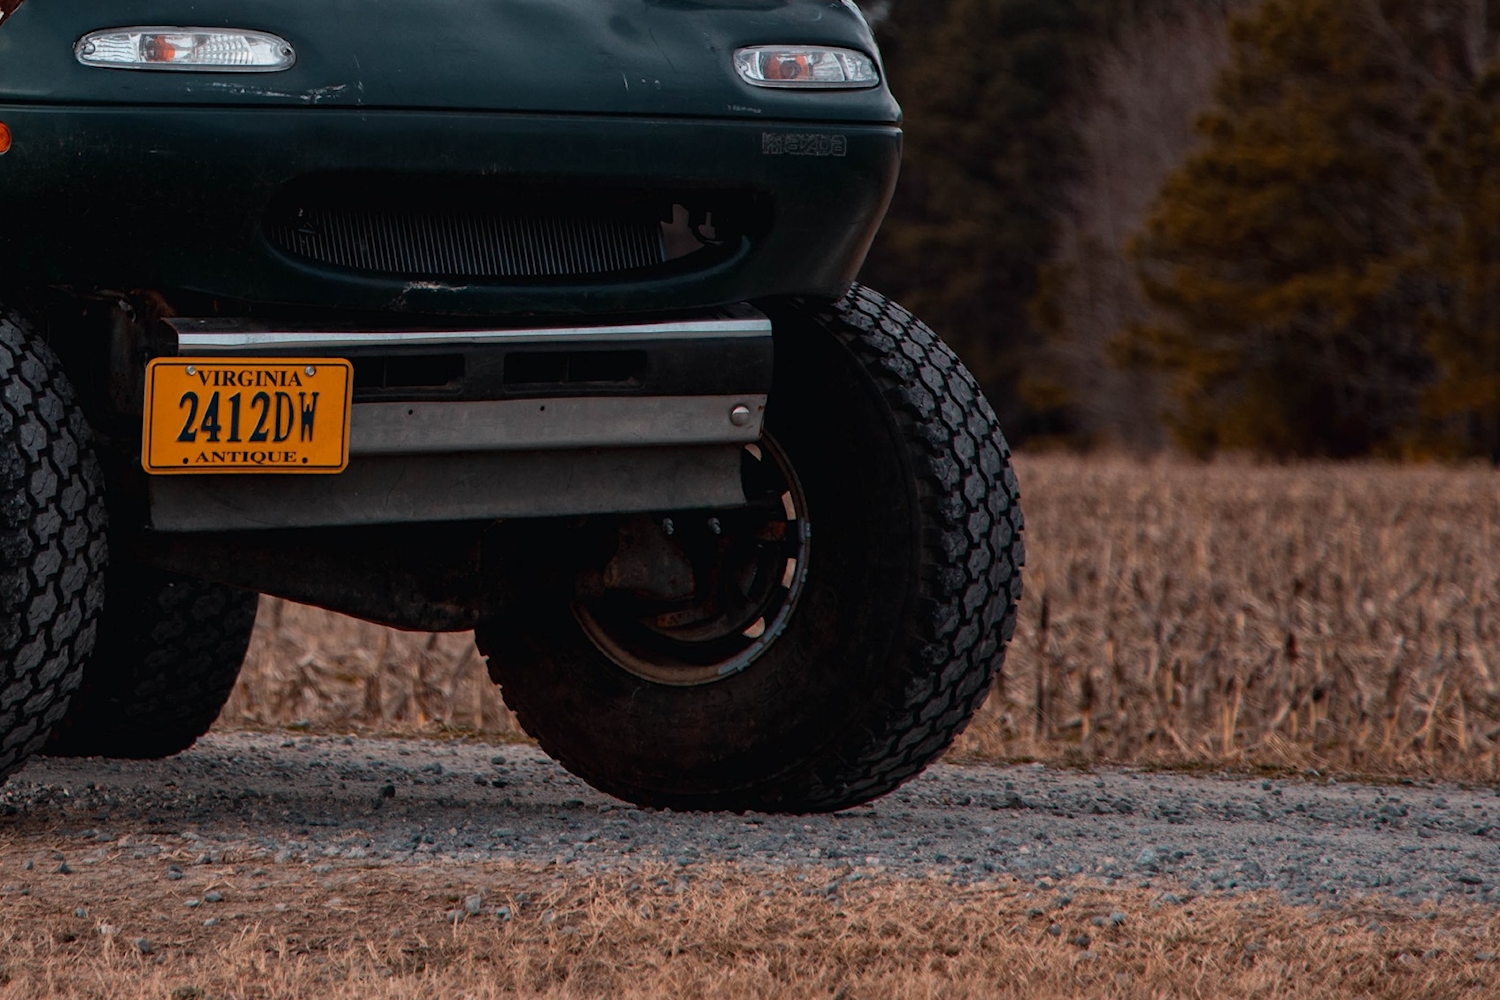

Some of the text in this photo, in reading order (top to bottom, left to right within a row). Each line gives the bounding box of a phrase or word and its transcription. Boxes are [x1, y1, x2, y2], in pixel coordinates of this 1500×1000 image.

[198, 370, 303, 387] VIRGINIA
[176, 390, 320, 443] 2412DW
[195, 451, 297, 466] ANTIQUE
